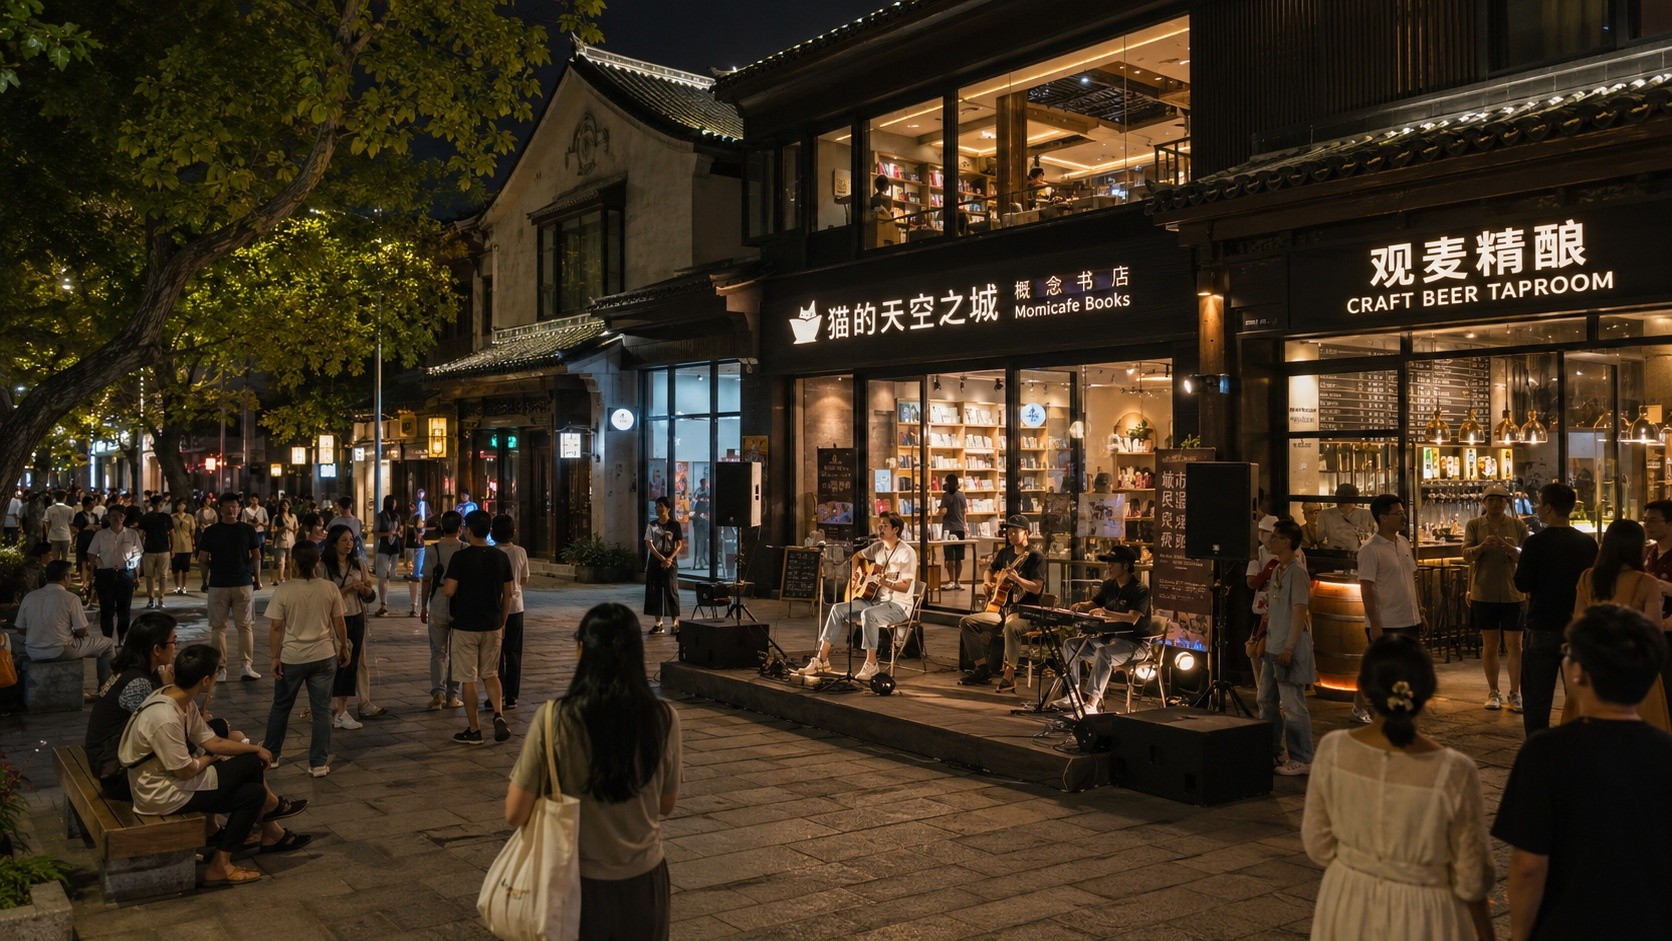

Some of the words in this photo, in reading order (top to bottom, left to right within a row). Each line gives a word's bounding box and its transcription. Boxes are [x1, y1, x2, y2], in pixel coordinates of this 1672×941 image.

[1370, 219, 1587, 288] 观麦精酿
[1014, 265, 1129, 300] 概念书店
[1015, 300, 1080, 319] Momicafe
[1084, 289, 1131, 311] Books
[1347, 292, 1414, 314] CRAFT
[1422, 285, 1479, 307] BEER
[1487, 271, 1614, 300] TAPROOM
[827, 283, 998, 340] 猫的天空之城
